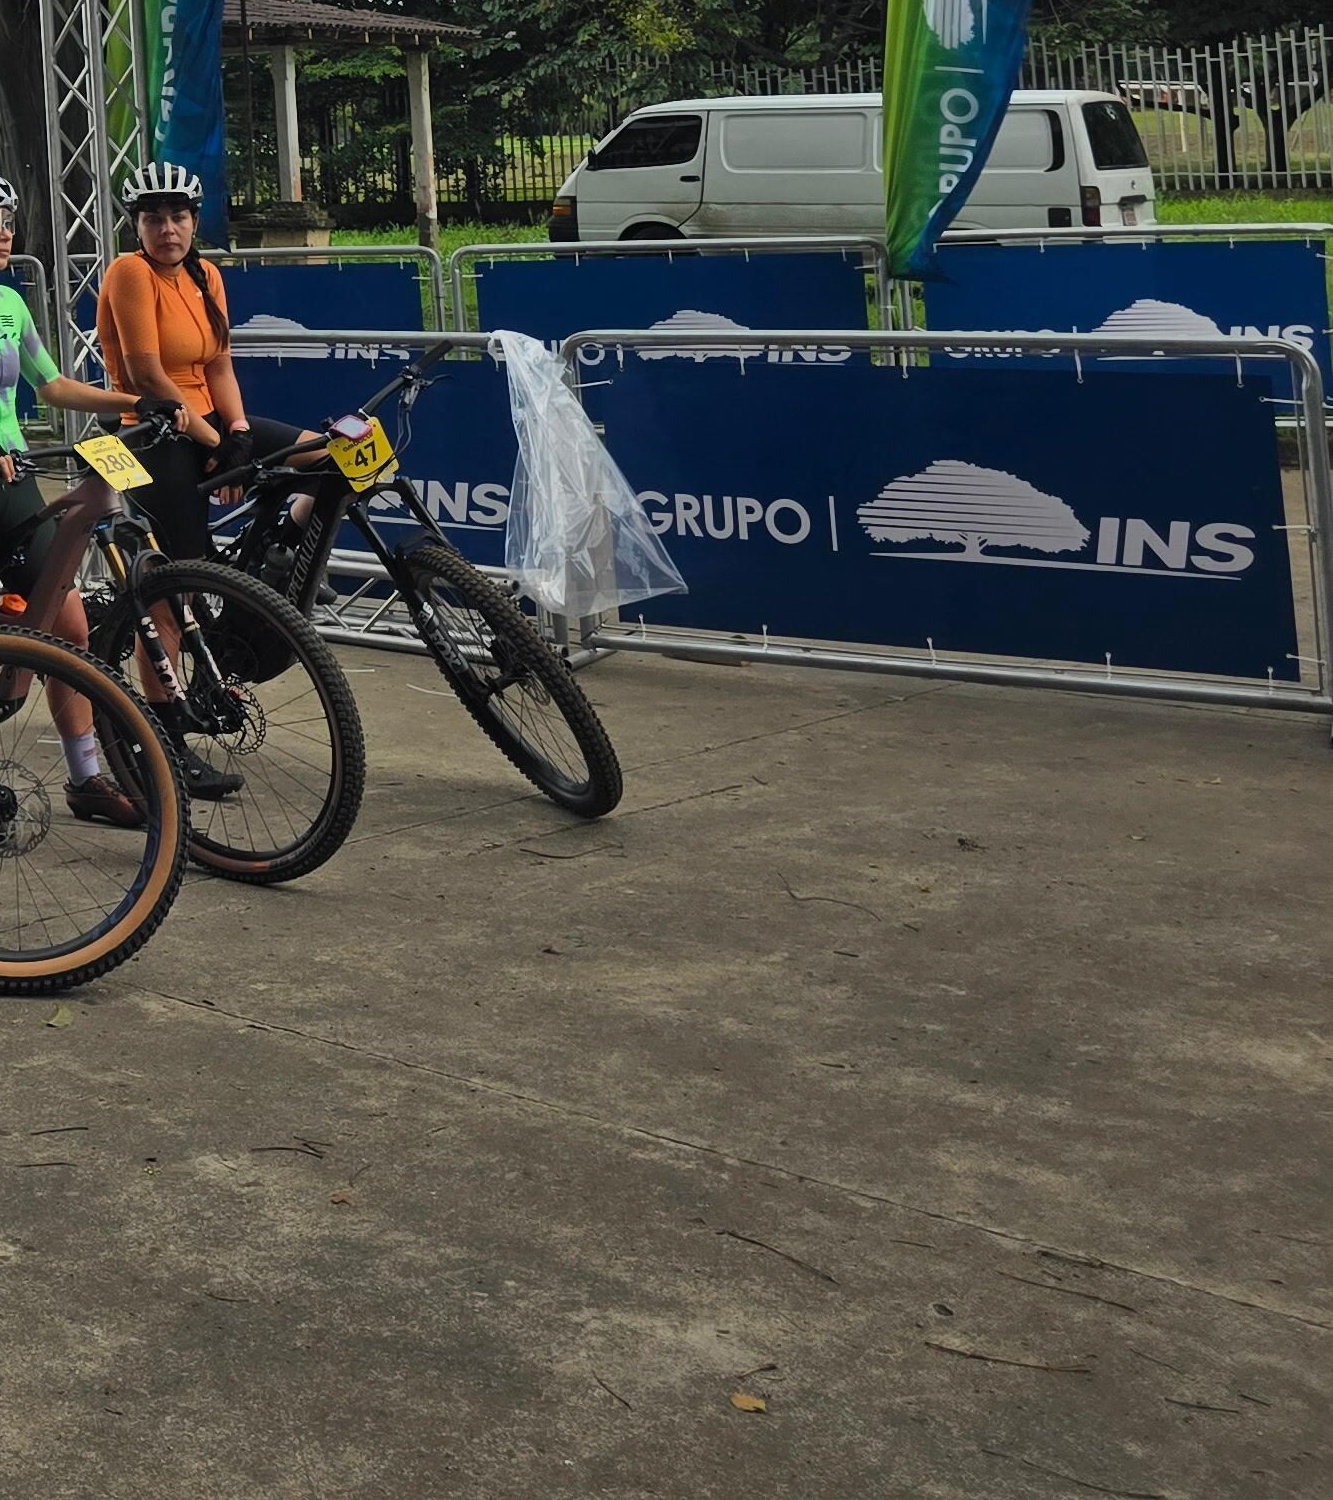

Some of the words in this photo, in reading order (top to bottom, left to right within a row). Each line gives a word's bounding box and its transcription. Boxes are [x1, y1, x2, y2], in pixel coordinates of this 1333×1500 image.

[928, 86, 979, 218] RUPO
[95, 452, 136, 475] 280
[354, 440, 378, 467] 47
[637, 490, 811, 545] GRUPO
[1095, 516, 1257, 574] INS
